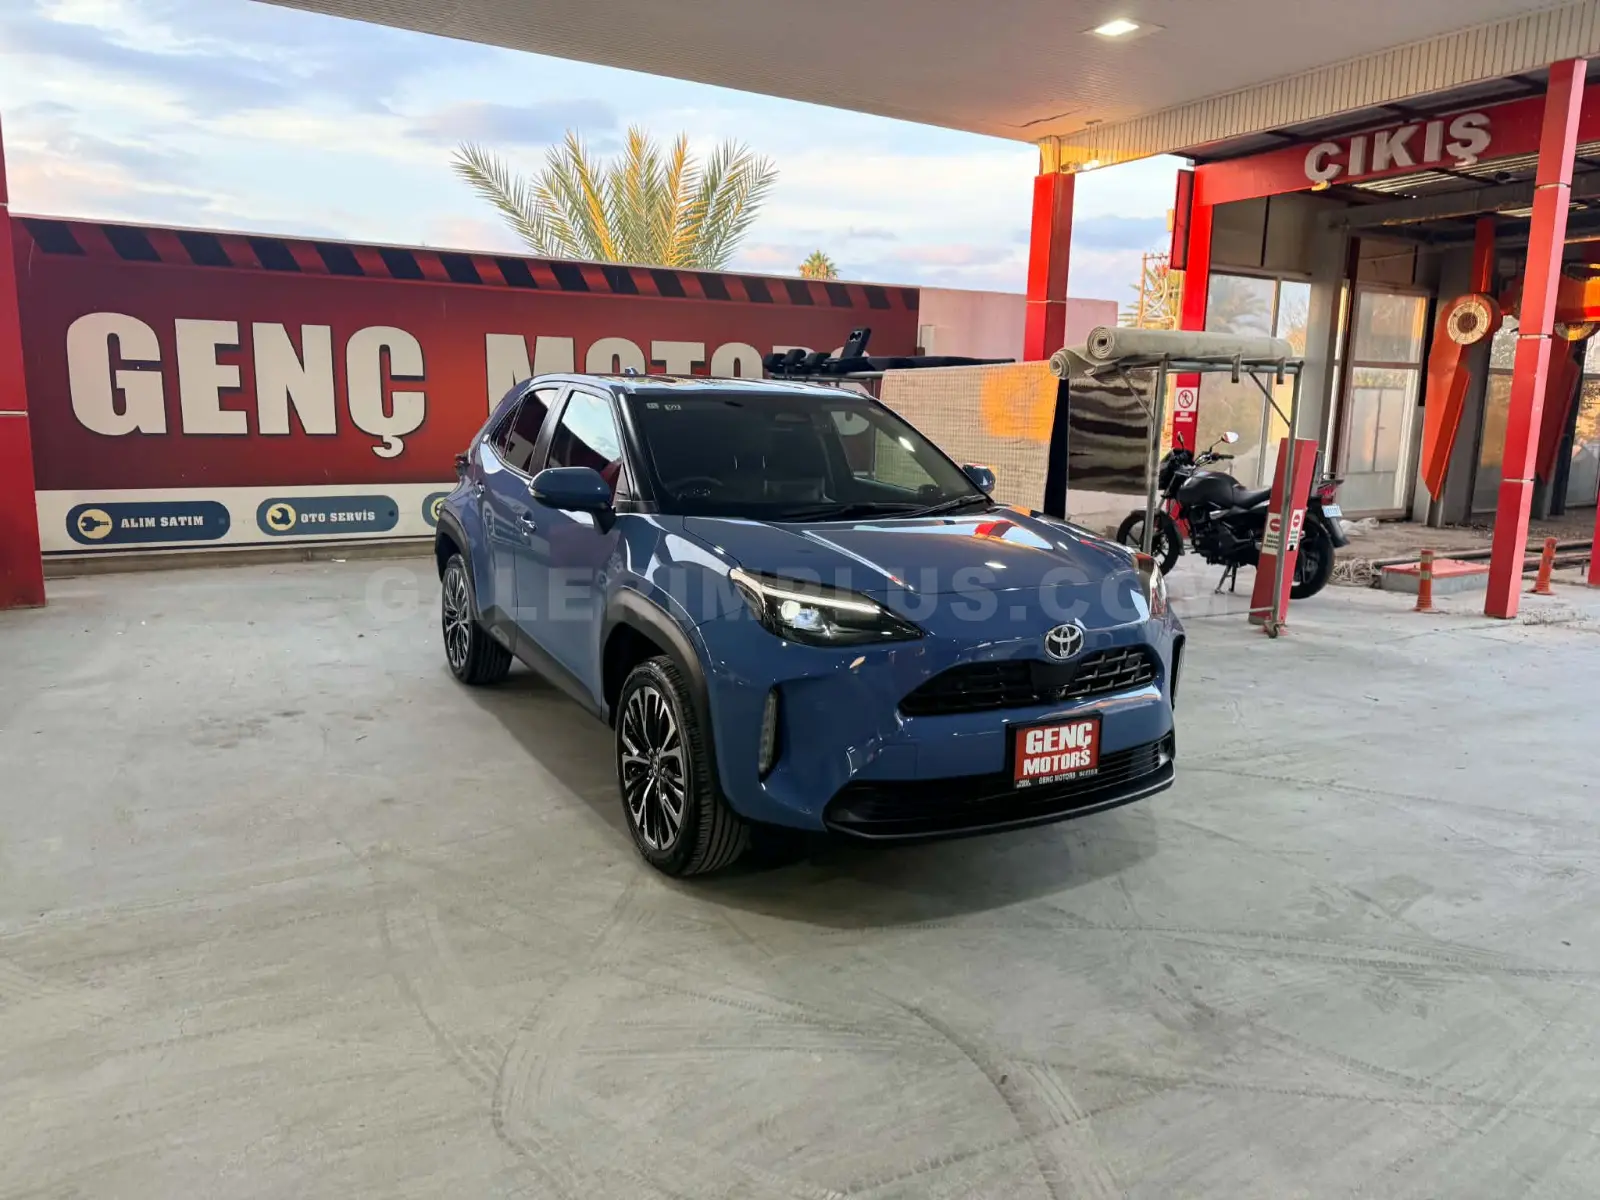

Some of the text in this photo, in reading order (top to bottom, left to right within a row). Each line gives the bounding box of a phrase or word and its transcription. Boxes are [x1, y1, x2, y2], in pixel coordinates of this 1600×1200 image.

[1304, 113, 1491, 191] ÇIKIŞ
[66, 311, 426, 458] GENÇ
[121, 516, 204, 528] ALIM SATIM
[301, 509, 376, 523] OTO SERVİS
[1025, 722, 1092, 755] GENÇ
[1023, 750, 1091, 776] MOTORS
